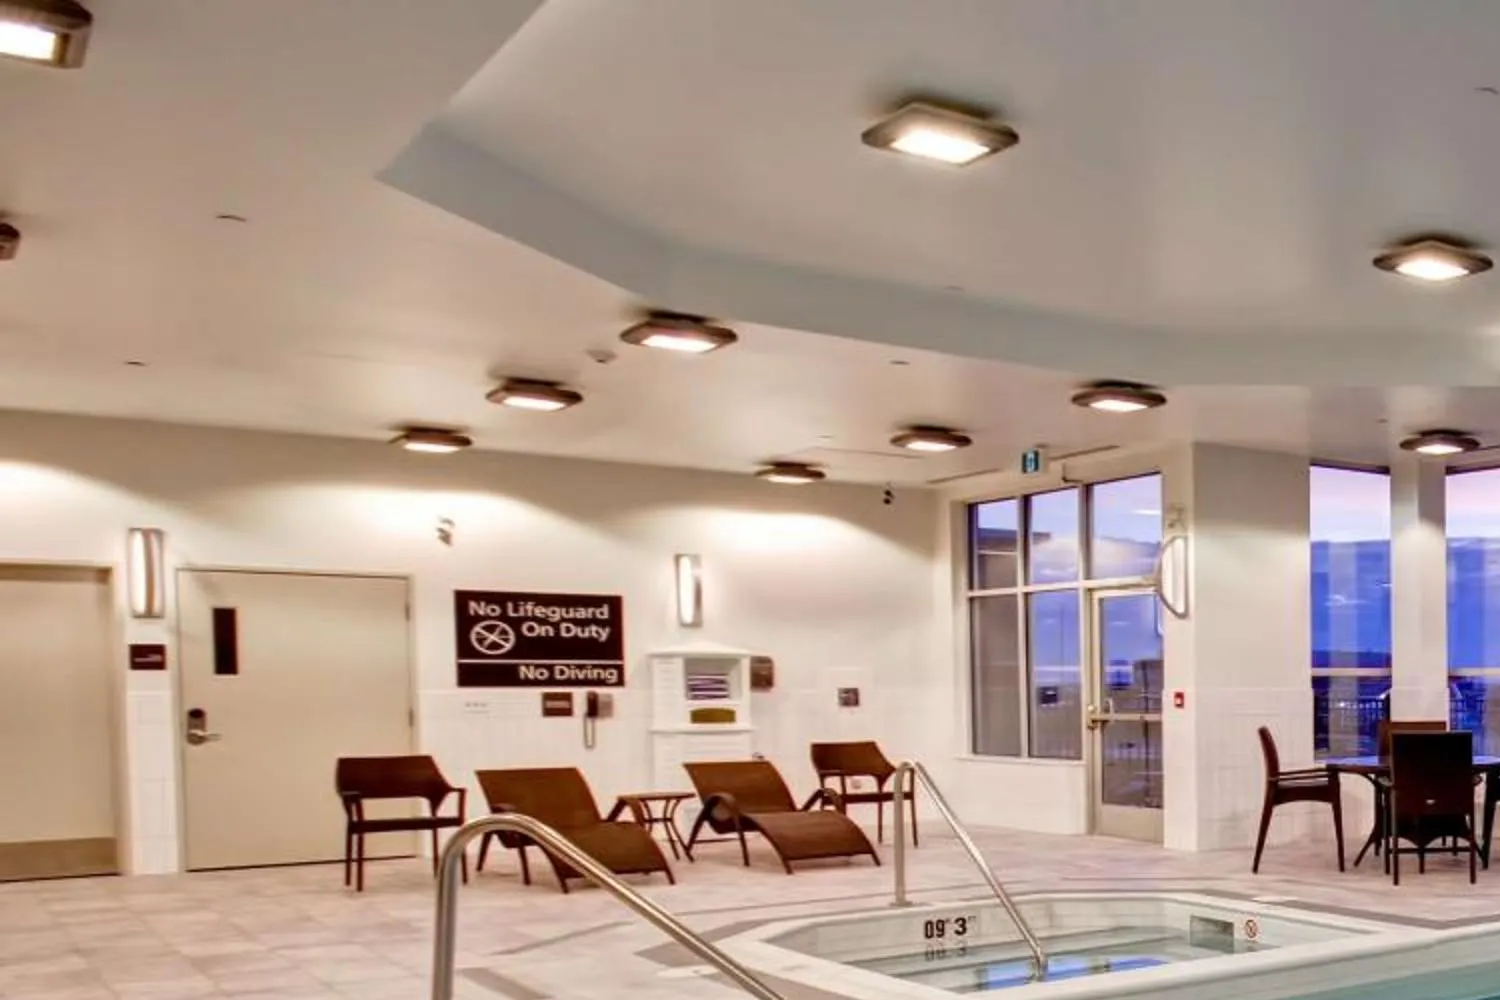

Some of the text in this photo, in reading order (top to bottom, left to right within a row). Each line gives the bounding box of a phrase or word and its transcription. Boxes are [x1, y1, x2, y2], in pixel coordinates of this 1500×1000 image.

[468, 600, 609, 621] No Lifeguard
[521, 621, 611, 643] On Duty
[518, 665, 619, 684] No Diving
